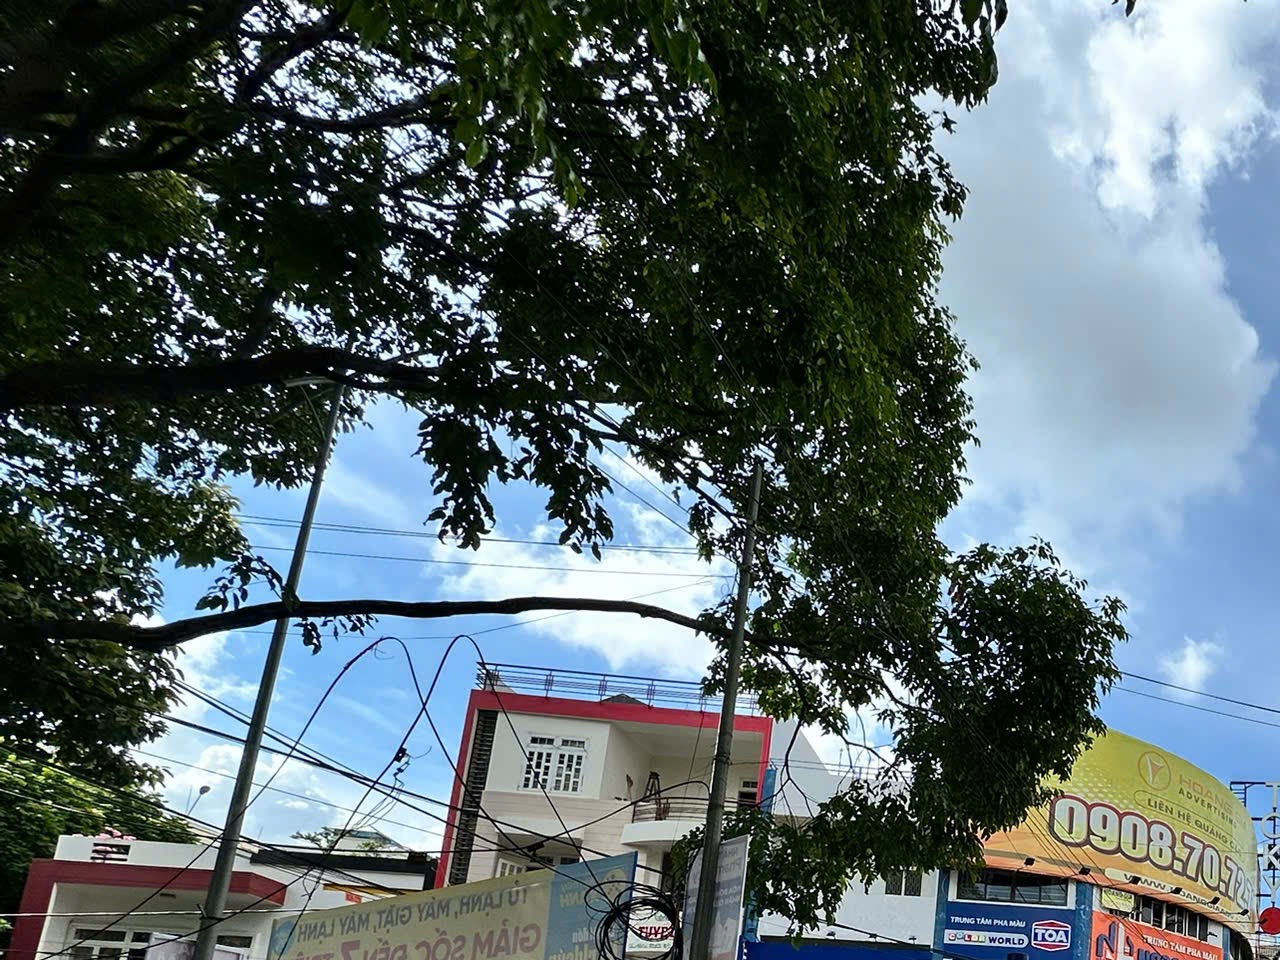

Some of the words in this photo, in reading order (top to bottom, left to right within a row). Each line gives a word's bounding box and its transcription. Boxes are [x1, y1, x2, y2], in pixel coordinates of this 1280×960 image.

[950, 916, 975, 924] TRUNG
[993, 919, 1009, 927] PHA
[988, 936, 1025, 945] WORLD
[1034, 928, 1068, 943] TOA
